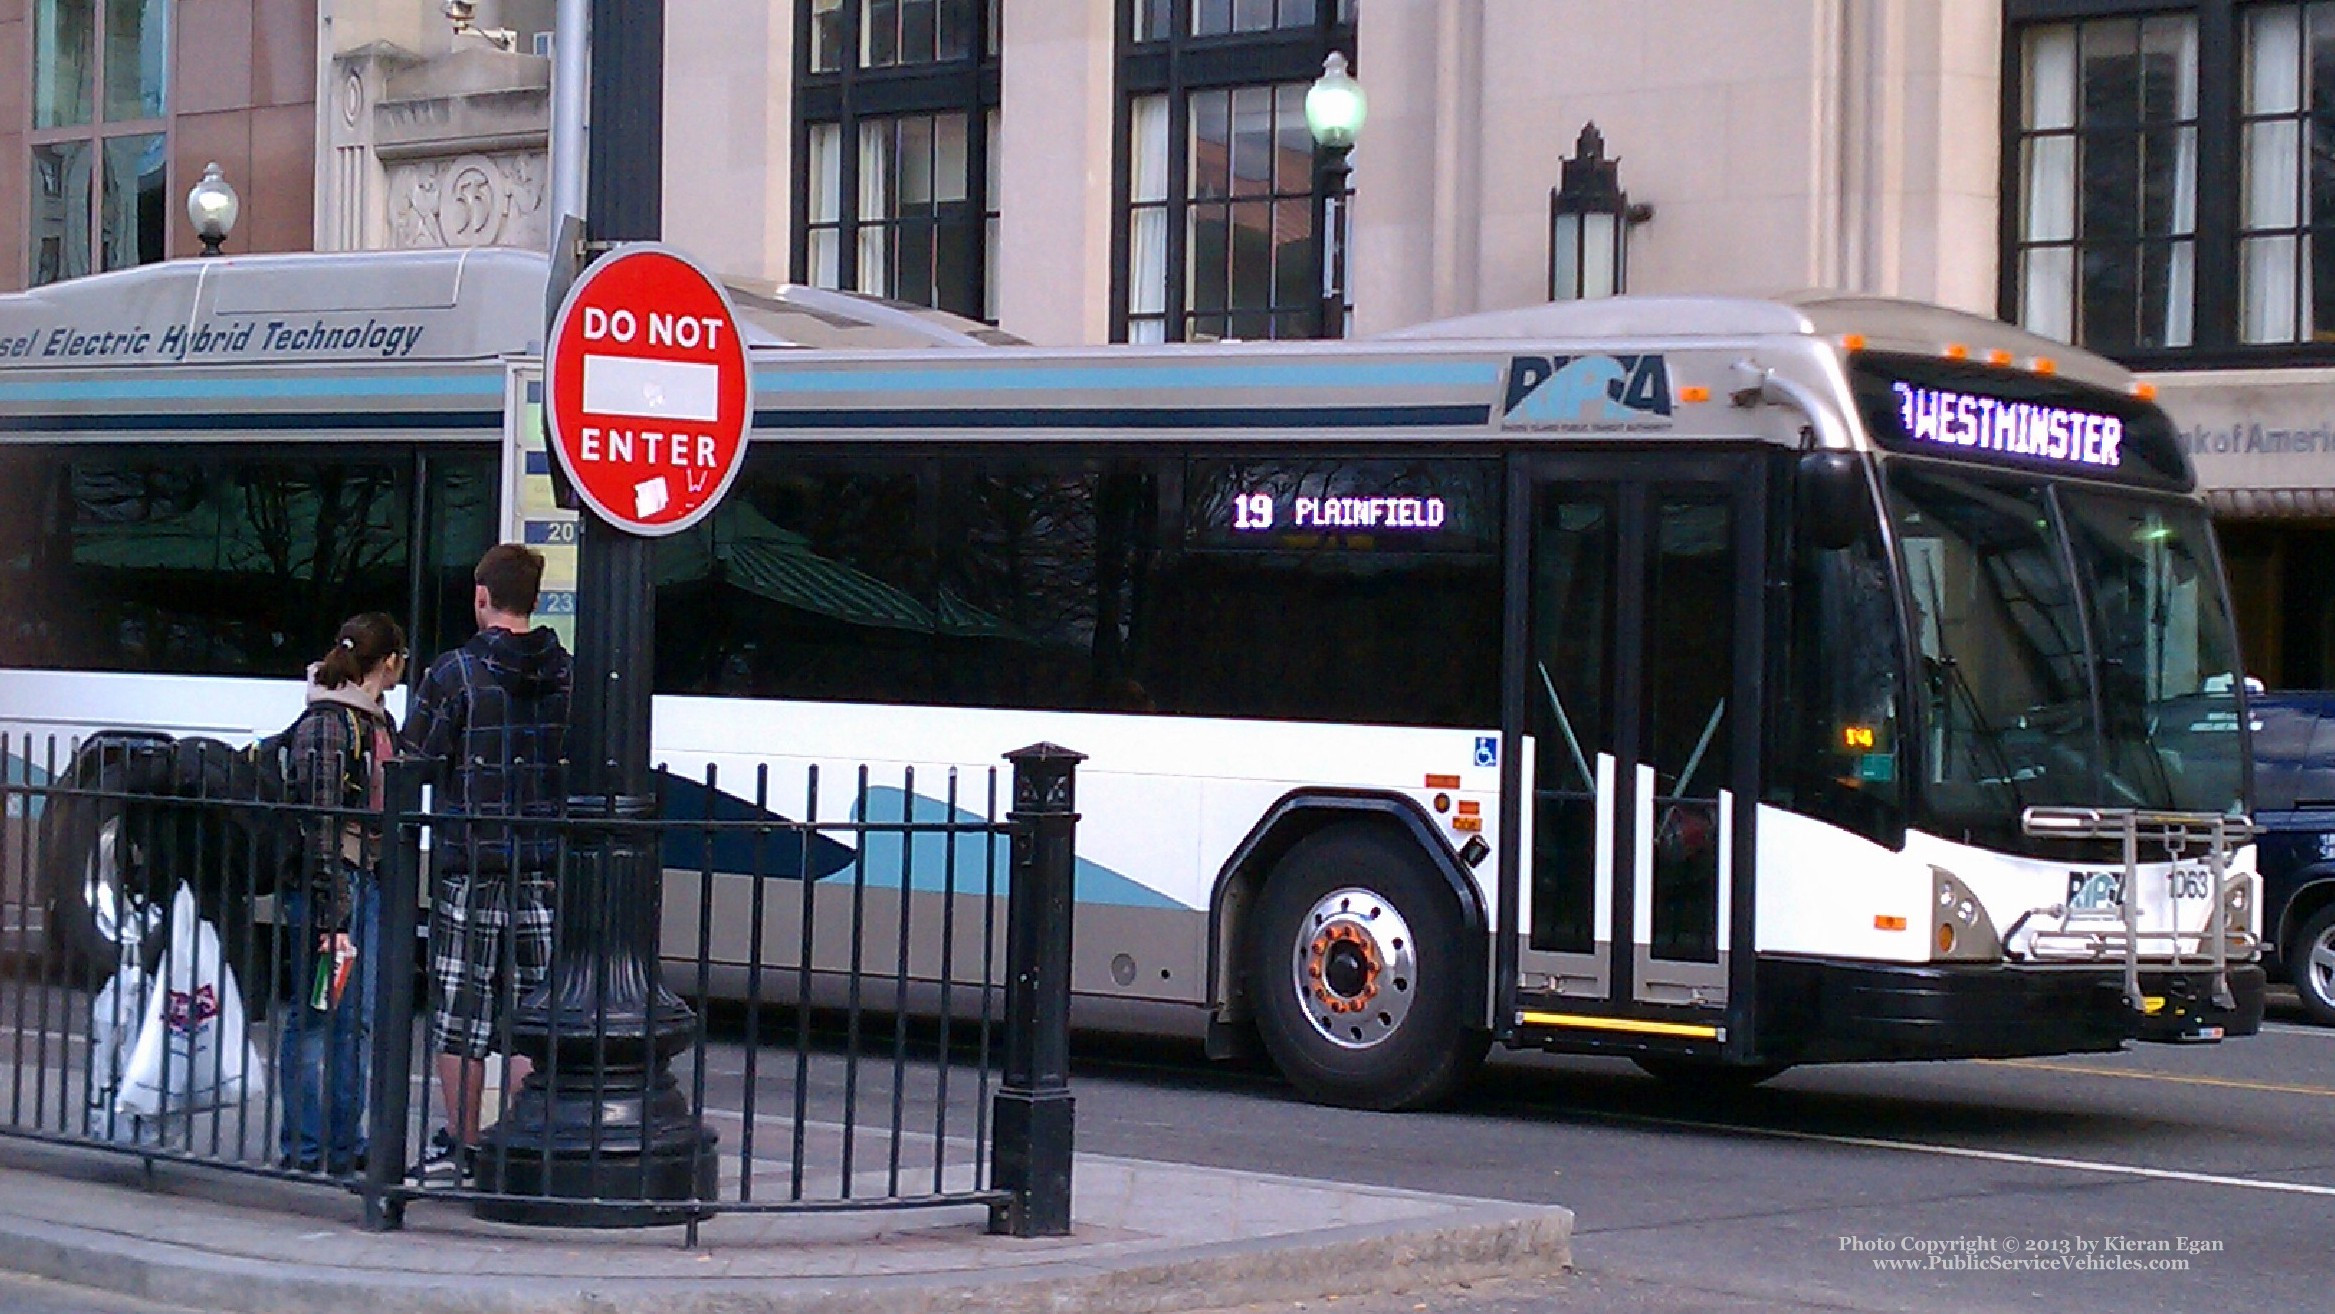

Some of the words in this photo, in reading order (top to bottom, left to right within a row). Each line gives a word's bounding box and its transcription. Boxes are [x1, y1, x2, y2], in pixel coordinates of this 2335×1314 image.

[42, 325, 151, 357] Electric
[157, 322, 256, 360] Hybrid
[262, 319, 424, 356] Technology
[583, 307, 636, 342] DO
[648, 313, 723, 350] NOT
[581, 427, 717, 468] ENTER
[1913, 388, 2124, 467] WESTMINSTER
[1233, 493, 1273, 528] 19
[1295, 497, 1445, 527] PLAINFIELD
[547, 522, 575, 541] 20
[547, 593, 575, 612] 23
